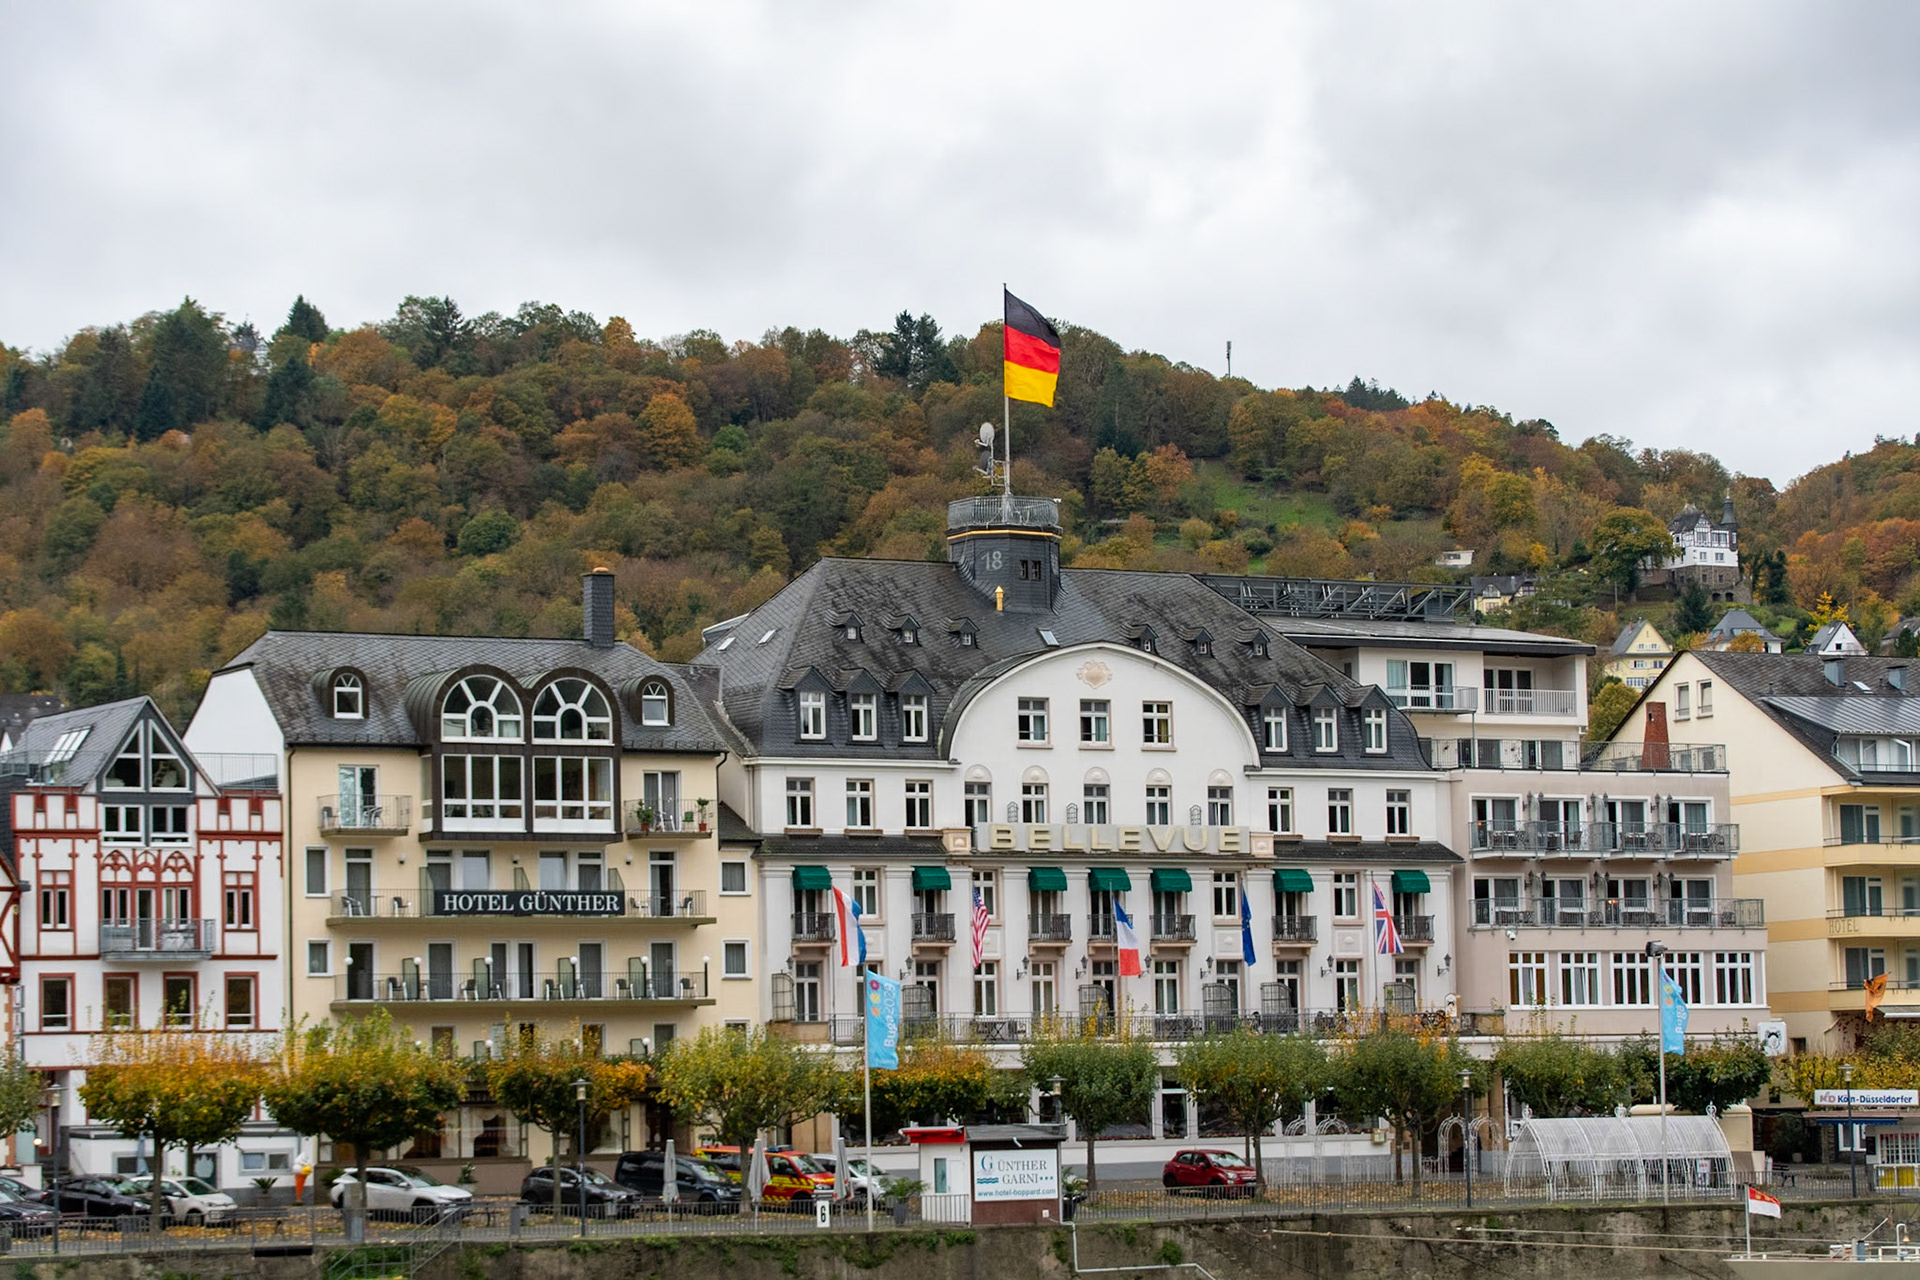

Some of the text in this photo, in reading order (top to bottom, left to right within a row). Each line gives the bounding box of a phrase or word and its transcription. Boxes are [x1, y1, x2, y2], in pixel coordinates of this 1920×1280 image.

[981, 551, 1003, 571] 18
[989, 824, 1241, 852] BELLEVUE
[443, 891, 620, 911] HOTEL GÜNTHER
[1829, 918, 1859, 933] HOTEL
[1002, 1174, 1038, 1184] GARNI
[978, 1188, 1056, 1197] www.hotel-boppard.com
[820, 1205, 827, 1223] 6
